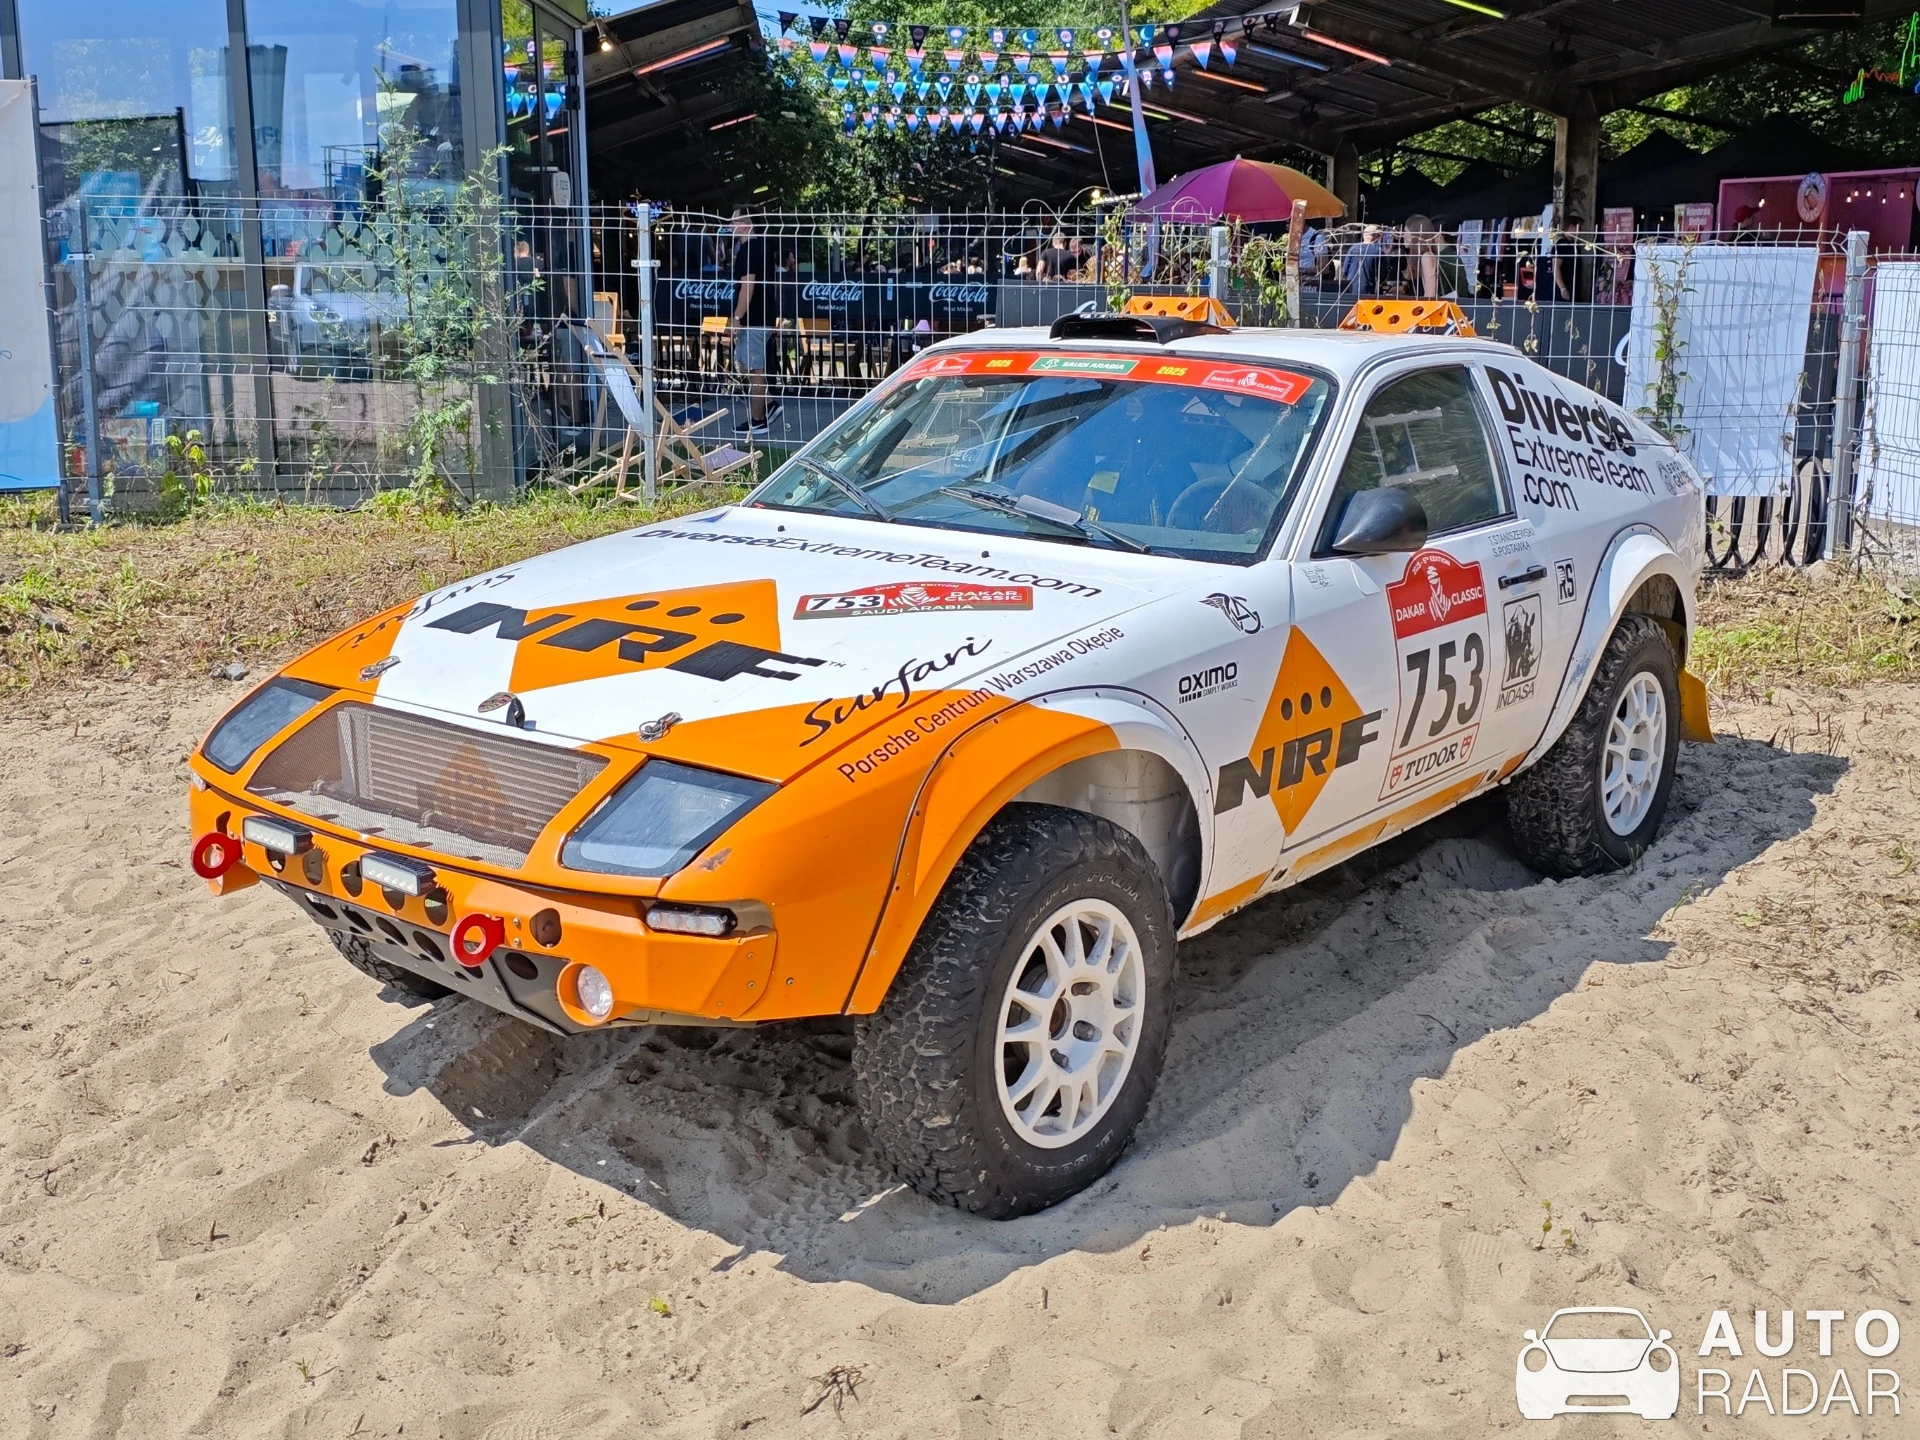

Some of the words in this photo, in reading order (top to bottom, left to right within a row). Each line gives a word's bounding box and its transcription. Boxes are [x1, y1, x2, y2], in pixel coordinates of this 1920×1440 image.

[802, 280, 863, 302] Coca-Cola
[929, 281, 990, 303] Coca-Cola
[985, 359, 1013, 368] 2025
[1090, 361, 1125, 371] ARABIA
[1156, 366, 1188, 377] 2025
[1210, 376, 1235, 384] DAKAR
[1256, 382, 1286, 393] CLASSIC
[1484, 365, 1637, 457] Diverse
[1507, 425, 1656, 495] ExtremeTeam
[1523, 473, 1580, 512] .com
[1487, 527, 1536, 546] T.STANISZEWSKI
[1430, 555, 1451, 567] EDITION
[1492, 541, 1532, 558] S.POSTAWKA
[810, 596, 882, 611] 753
[851, 608, 904, 616] SAUDI
[906, 604, 974, 613] ARABIA
[1396, 602, 1426, 623] DAKAR
[1451, 586, 1483, 606] CLASSIC
[423, 601, 828, 682] NRF
[1178, 661, 1238, 695] OXIMO
[1202, 685, 1222, 698] SIMPLY
[1222, 679, 1238, 692] WORKS
[1399, 632, 1484, 749] 753
[798, 636, 993, 748] Surfari
[837, 727, 921, 784] Porsche
[913, 686, 995, 736] Centrum
[984, 646, 1075, 694] Warszawa
[1067, 624, 1125, 656] Okęcie
[1496, 681, 1536, 710] INDASA
[1214, 710, 1382, 816] NRF
[1404, 743, 1459, 782] TUDOR
